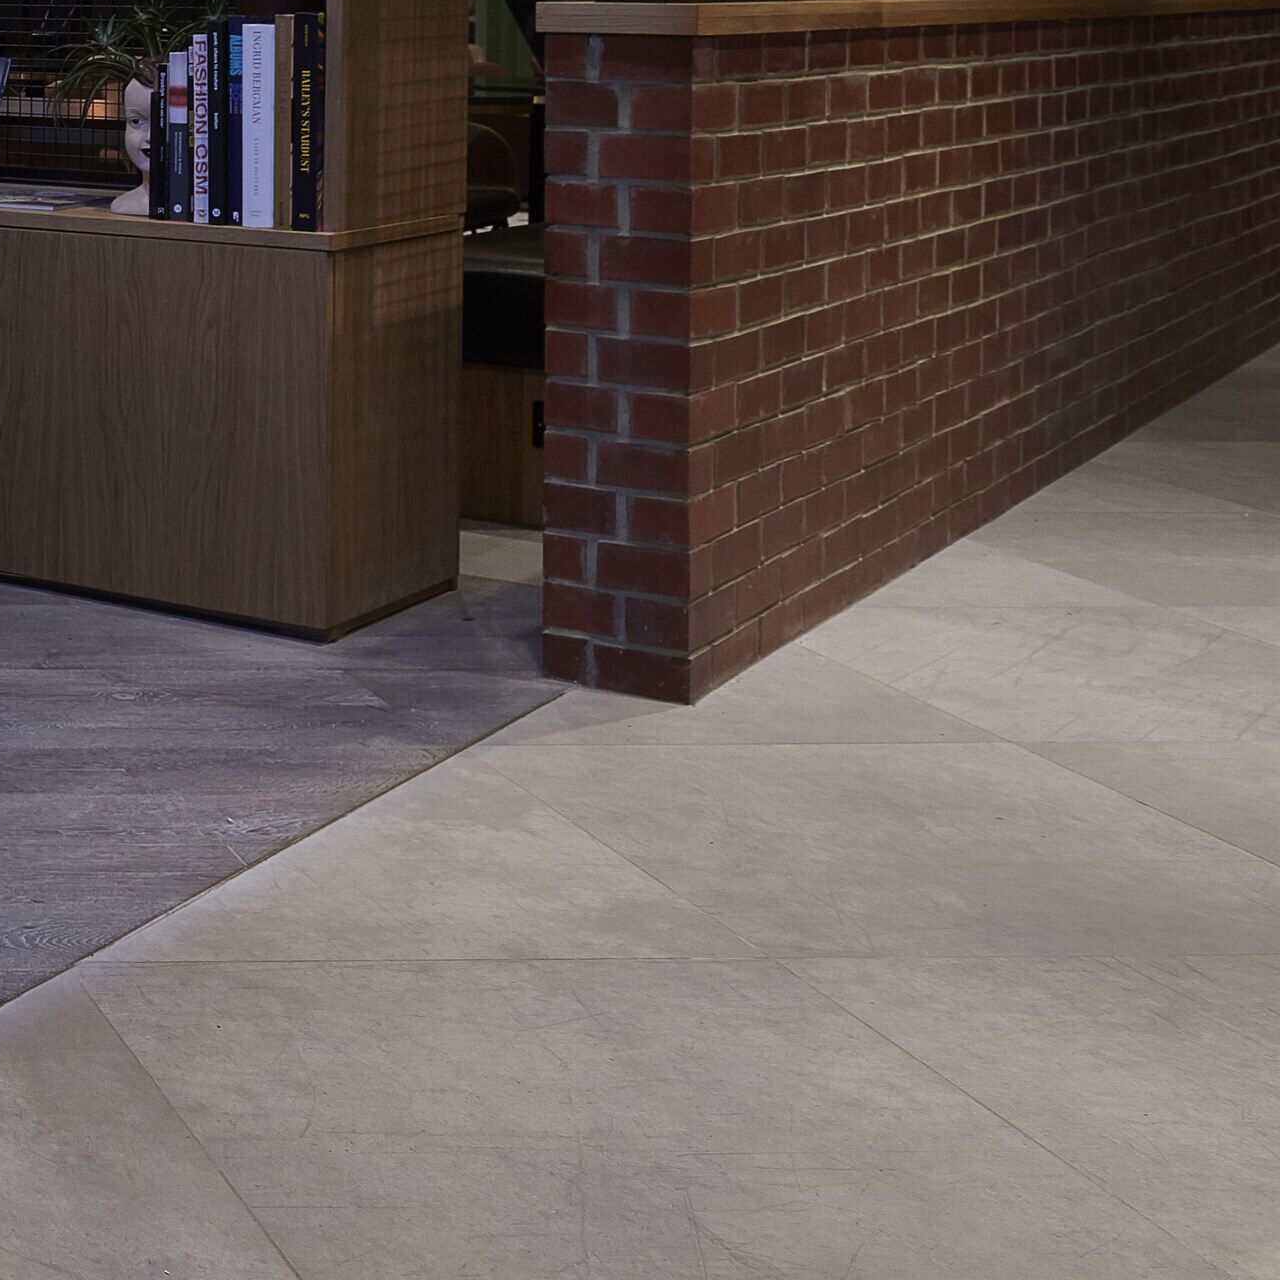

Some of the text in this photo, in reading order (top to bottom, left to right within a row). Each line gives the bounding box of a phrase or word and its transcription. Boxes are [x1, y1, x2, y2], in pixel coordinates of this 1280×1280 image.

[228, 33, 243, 77] ALBUMS
[252, 30, 262, 70] INGRID
[159, 71, 167, 97] Brooklyn
[252, 71, 262, 125] BERGMAN
[194, 39, 208, 196] FASHION CSM
[299, 69, 312, 174] BAILEY'S STARDUST
